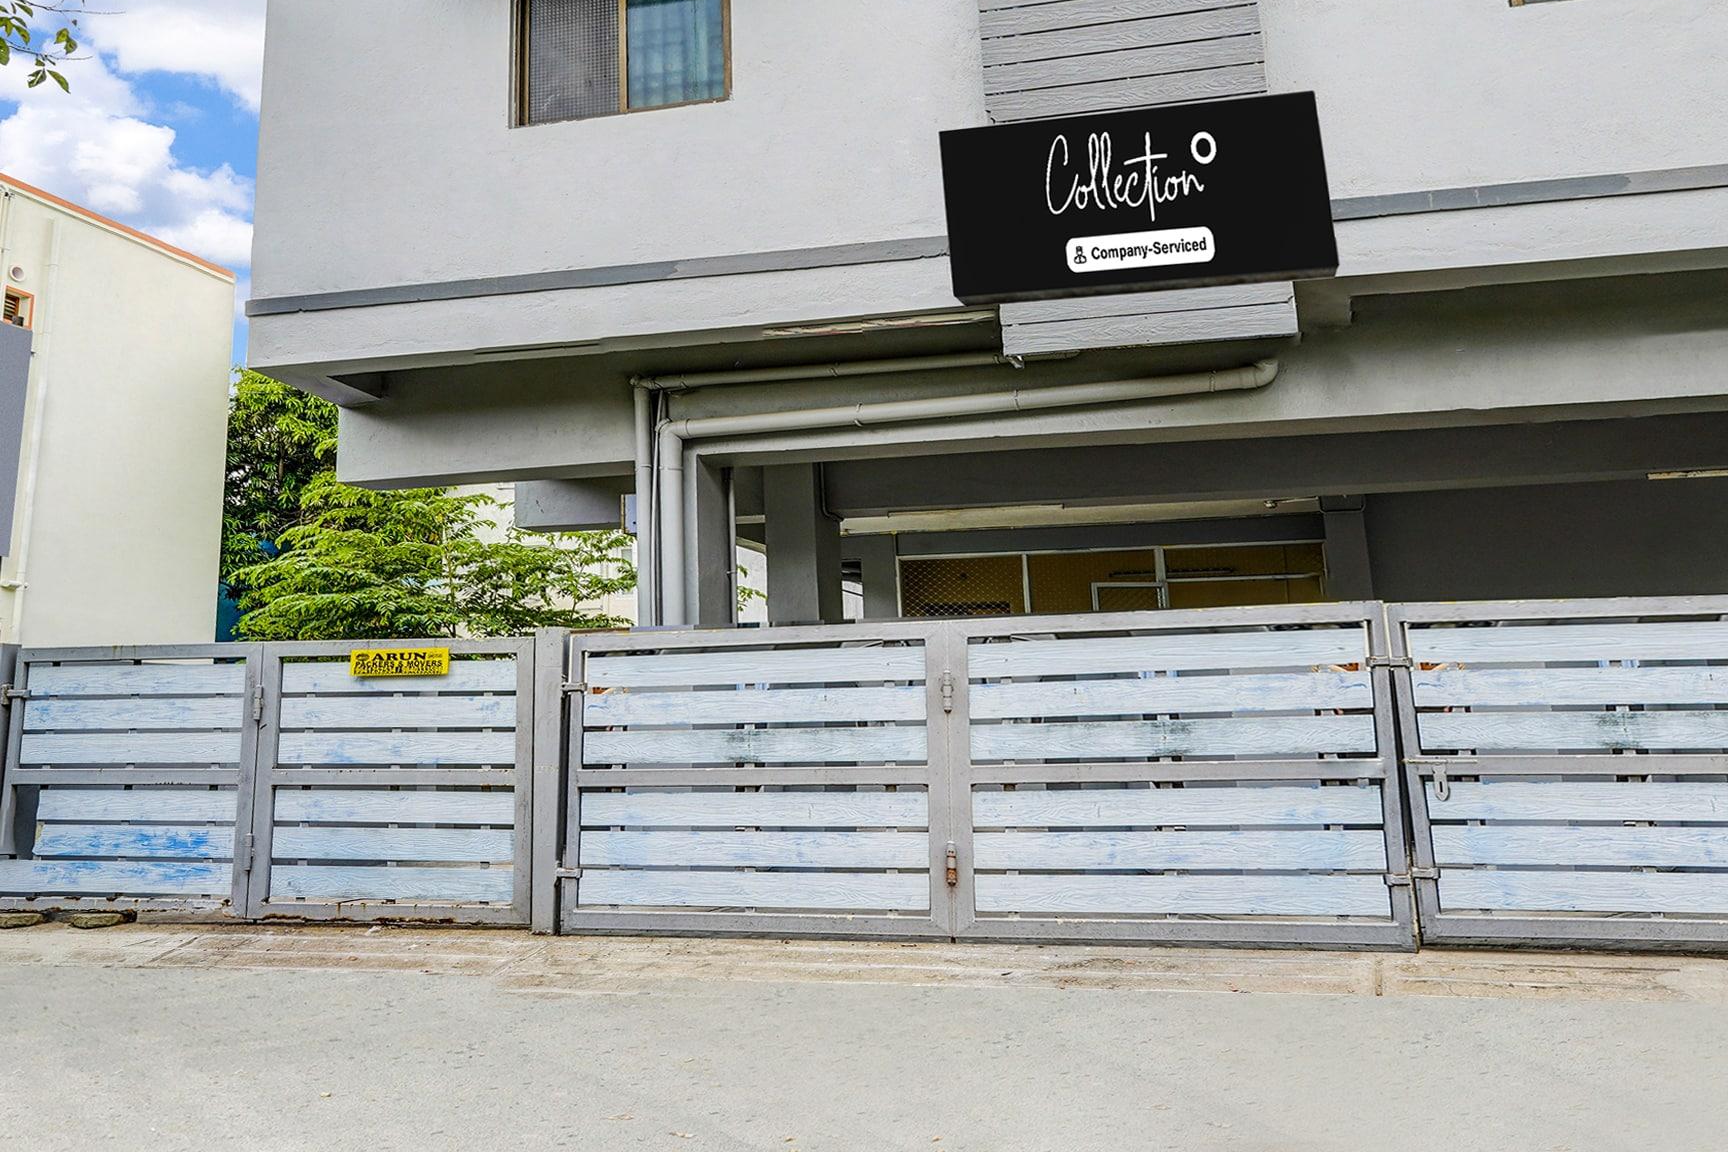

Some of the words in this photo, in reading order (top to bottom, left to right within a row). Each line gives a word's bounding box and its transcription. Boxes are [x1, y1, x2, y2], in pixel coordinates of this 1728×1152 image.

[1046, 131, 1205, 222] Collection
[1091, 237, 1208, 261] Company-Serviced
[355, 660, 395, 668] PACKERS
[407, 659, 443, 667] MOVERS
[372, 652, 427, 661] ARUN
